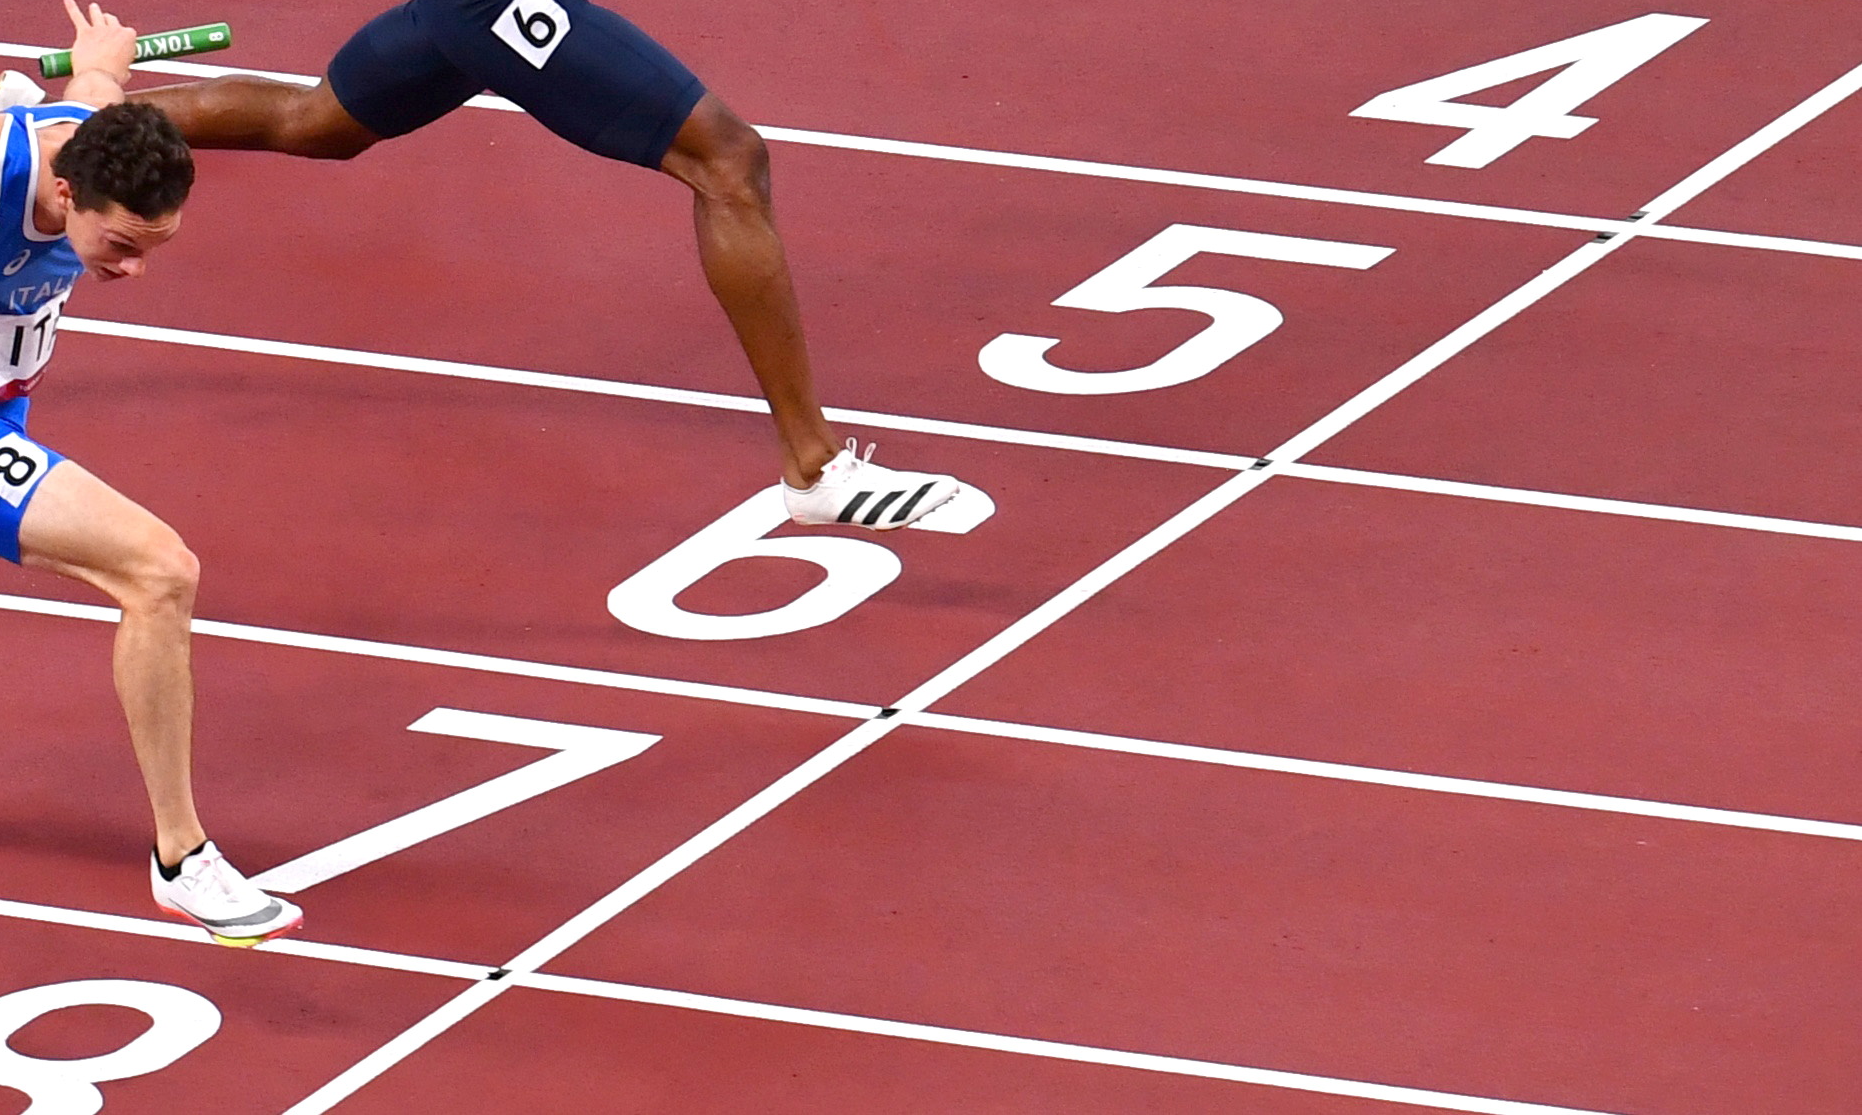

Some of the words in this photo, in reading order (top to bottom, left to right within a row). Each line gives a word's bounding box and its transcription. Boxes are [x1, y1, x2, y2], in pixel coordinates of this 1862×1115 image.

[512, 5, 557, 49] 6
[1348, 13, 1711, 169] 4
[978, 223, 1397, 395] 5
[607, 472, 996, 640] 6
[246, 706, 663, 894] 7
